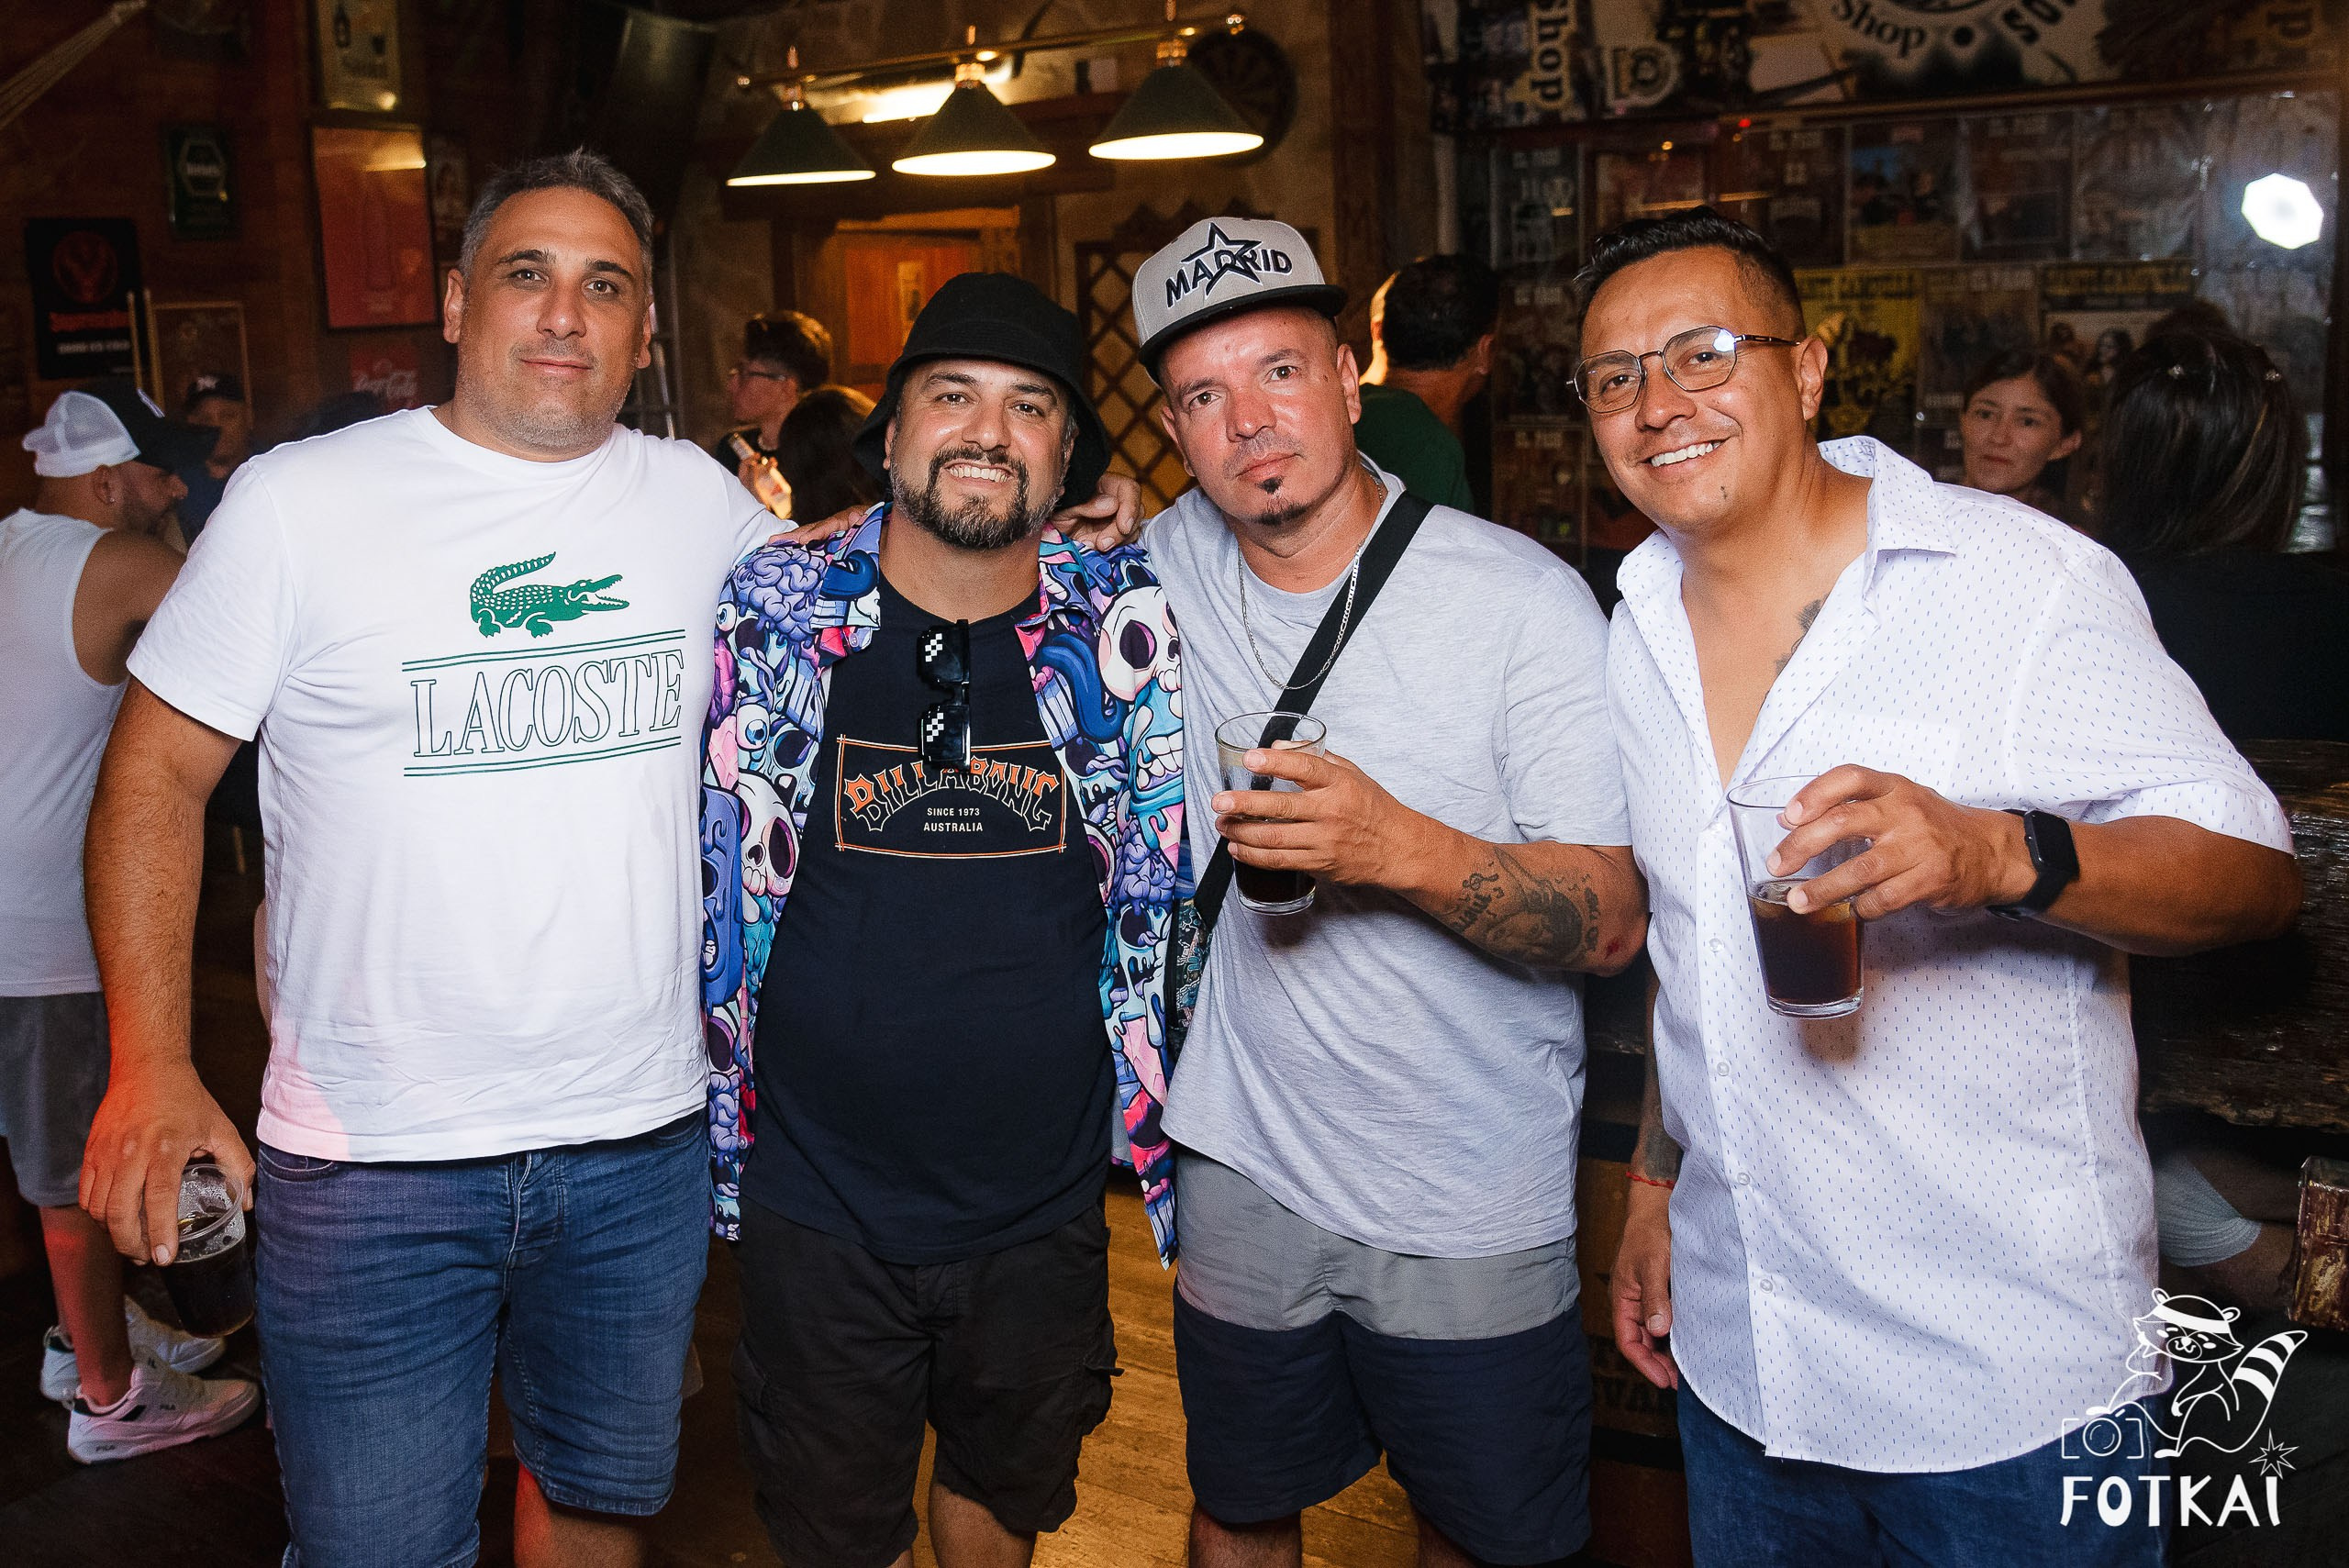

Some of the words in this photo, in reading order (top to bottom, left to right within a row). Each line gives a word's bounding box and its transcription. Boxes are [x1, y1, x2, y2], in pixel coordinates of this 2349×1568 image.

[1165, 249, 1293, 309] MADRID
[410, 650, 685, 758] LACOSTE
[923, 822, 984, 832] AUSTRALIA
[927, 807, 954, 817] SINCE
[958, 807, 980, 817] 1973
